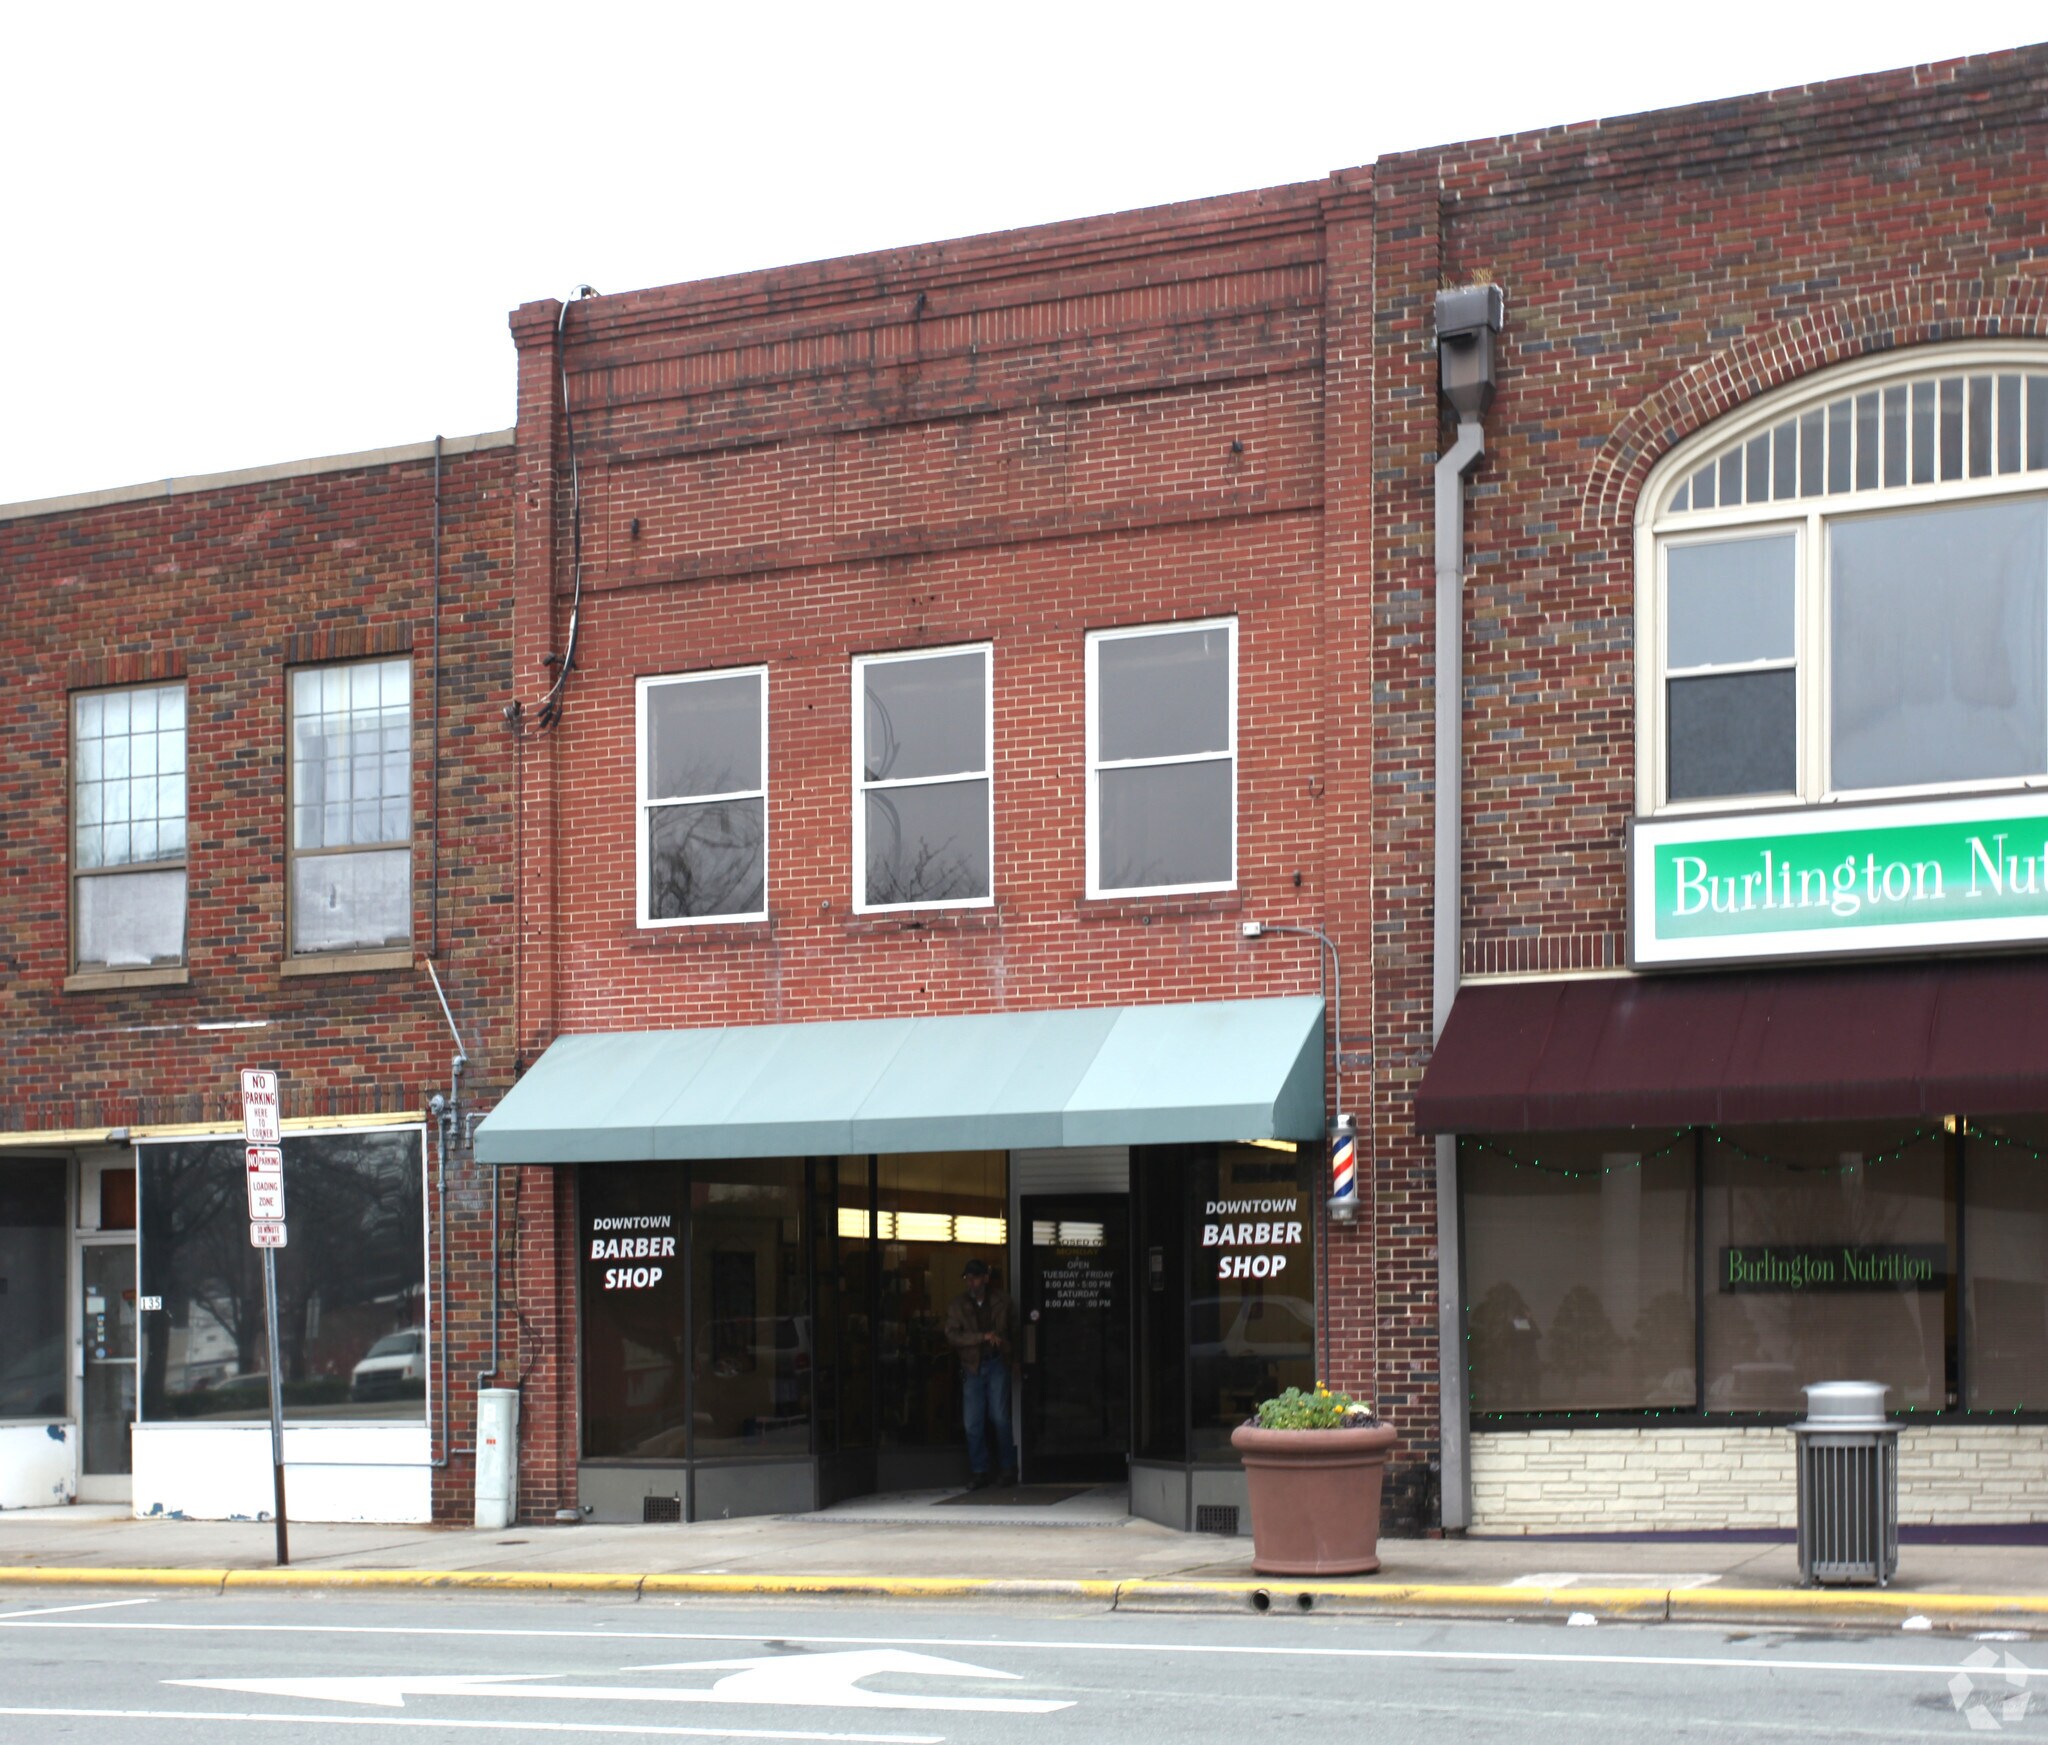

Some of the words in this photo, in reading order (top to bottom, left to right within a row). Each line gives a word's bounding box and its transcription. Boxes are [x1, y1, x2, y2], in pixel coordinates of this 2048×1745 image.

[1671, 849, 1946, 917] Burlington
[252, 1076, 266, 1089] NO
[245, 1091, 275, 1105] PARKING
[254, 1108, 268, 1118] HERE
[258, 1119, 266, 1127] TO
[252, 1128, 273, 1138] CORNER
[248, 1153, 258, 1168] NO
[258, 1156, 279, 1166] PARKING
[253, 1181, 278, 1191] LOADING
[259, 1197, 274, 1207] ZONE
[1205, 1198, 1297, 1215] DOWNTOWN
[593, 1215, 671, 1231] DOWNTOWN
[1202, 1221, 1303, 1247] BARBER
[591, 1236, 676, 1260] BARBER
[1056, 1247, 1099, 1256] MONDAY
[1067, 1261, 1090, 1269] OPEN
[1217, 1255, 1287, 1279] SHOP
[1729, 1248, 1835, 1288] Burlington
[1842, 1248, 1932, 1282] Nutrition
[604, 1267, 663, 1290] SHOP
[1043, 1271, 1079, 1279] TUESDAY
[1085, 1271, 1114, 1279] FRIDAY
[1062, 1280, 1076, 1288] AM
[1099, 1280, 1111, 1288] PM
[1057, 1290, 1100, 1298] SATURDAY
[143, 1297, 160, 1309] 135
[1062, 1300, 1076, 1308] AM
[1099, 1300, 1111, 1308] PM
